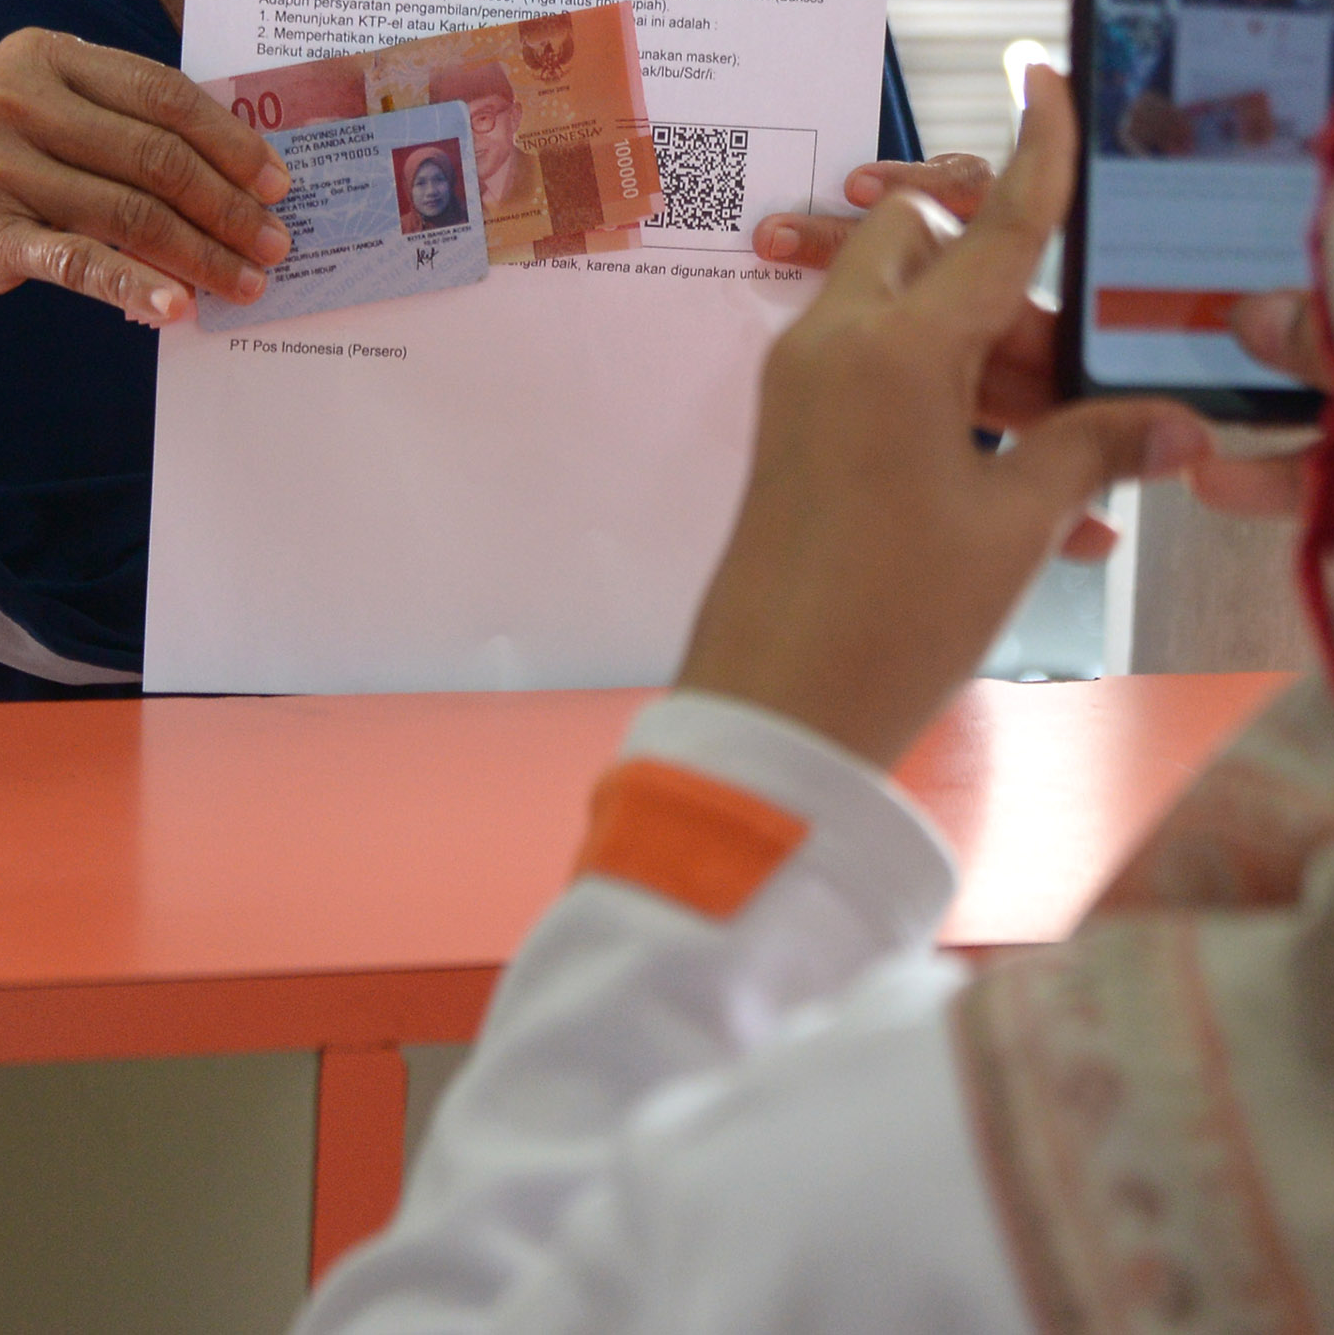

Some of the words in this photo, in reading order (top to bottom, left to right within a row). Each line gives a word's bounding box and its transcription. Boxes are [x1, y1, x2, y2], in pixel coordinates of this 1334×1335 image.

[395, 0, 556, 20] pengambilan/penerimaan
[631, 0, 669, 14] upiah).
[275, 11, 353, 28] Menunjukan
[358, 15, 403, 30] KTP-el
[407, 19, 435, 31] atau
[651, 16, 665, 27] ini
[669, 17, 711, 30] adalah
[274, 27, 374, 45] Memperhatikan
[257, 42, 303, 58] Berikut
[306, 46, 350, 59] adalah
[686, 51, 740, 66] masker);
[642, 65, 716, 81] ak/Ibu/Sdr/i:
[285, 144, 311, 156] KOTA
[313, 138, 346, 151] BANDA
[348, 132, 374, 144] ACEH
[291, 129, 338, 144] PROVINSI
[339, 125, 366, 137] ACEH
[522, 127, 601, 151] INDONESIA
[286, 146, 379, 171] 026309790005
[614, 138, 639, 199] 100000
[551, 257, 582, 271] baik,
[586, 259, 630, 274] karena
[635, 262, 666, 276] akan
[670, 265, 736, 280] digunakan
[739, 268, 771, 280] untuk
[774, 268, 802, 281] bukti
[229, 339, 249, 352] PT
[253, 340, 277, 353] Pos
[282, 341, 344, 356] Indonesia
[348, 343, 408, 361] (Persero)
